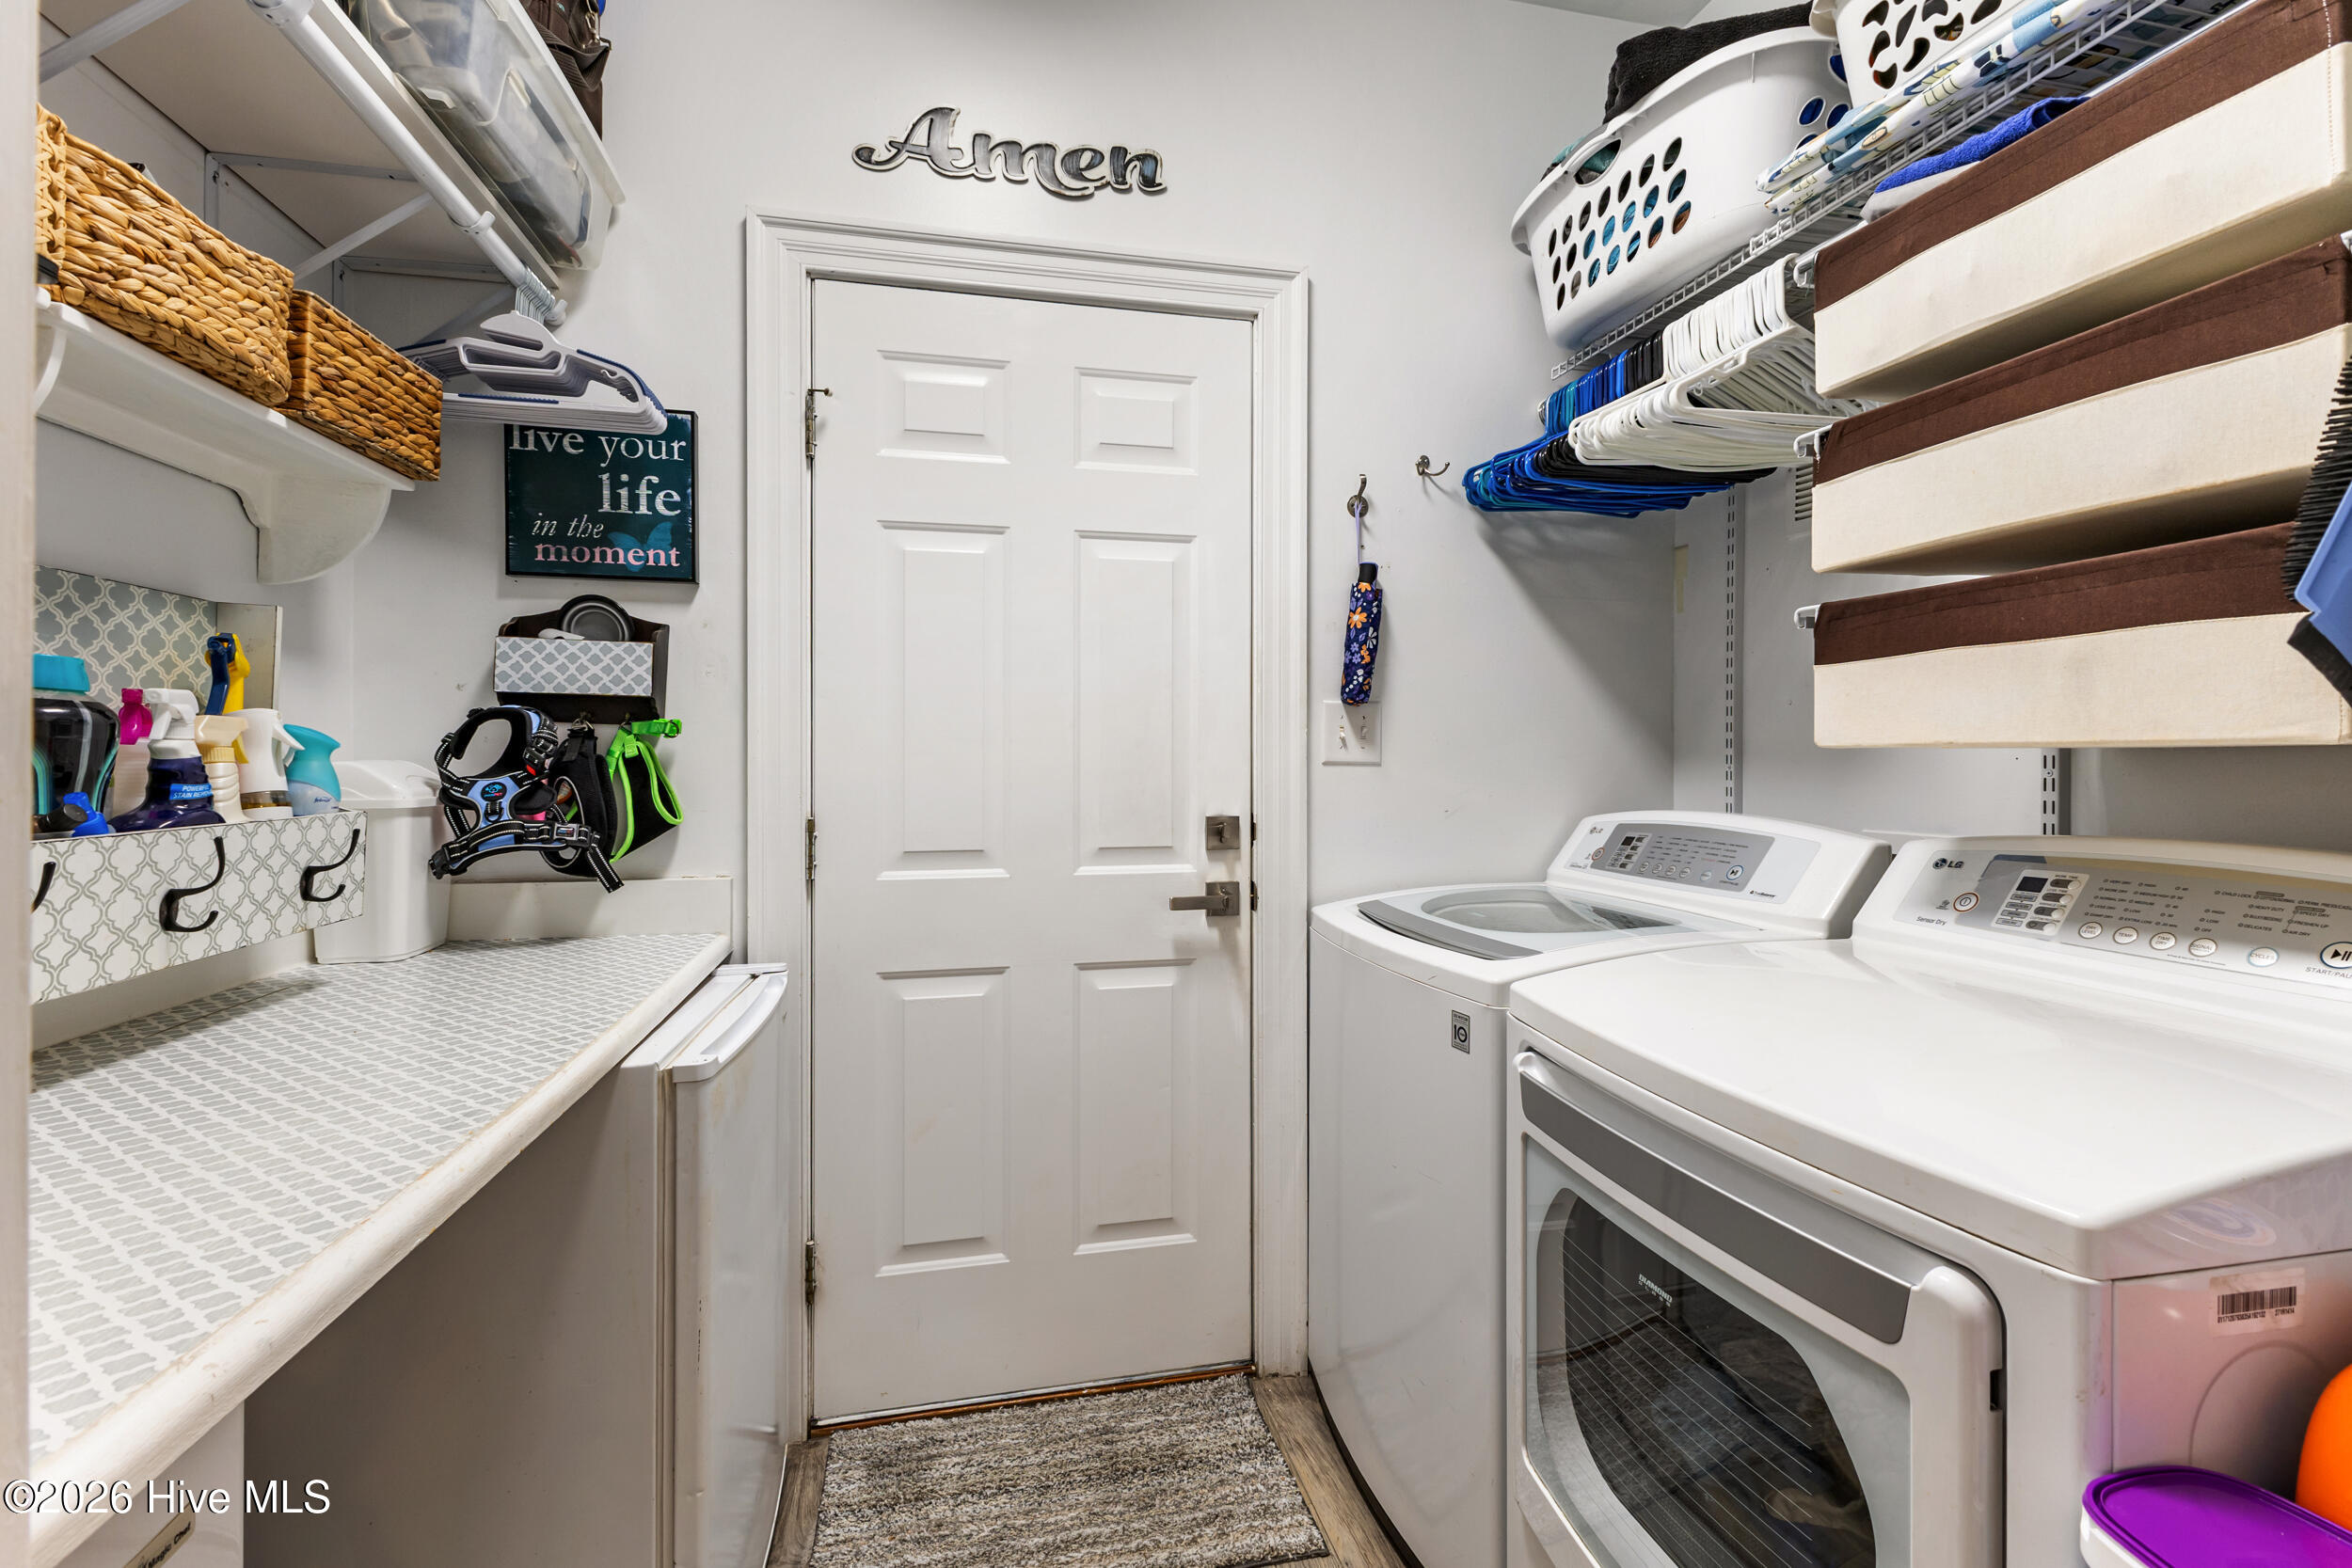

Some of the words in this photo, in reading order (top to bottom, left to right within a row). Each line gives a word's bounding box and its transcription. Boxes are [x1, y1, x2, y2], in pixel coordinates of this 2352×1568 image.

[851, 106, 1168, 198] Amen
[509, 424, 584, 454] live
[597, 436, 687, 467] your
[597, 472, 682, 516] life
[532, 512, 558, 537] in
[566, 515, 605, 538] the
[534, 543, 681, 567] moment
[1639, 1274, 1673, 1303] DIAMOND
